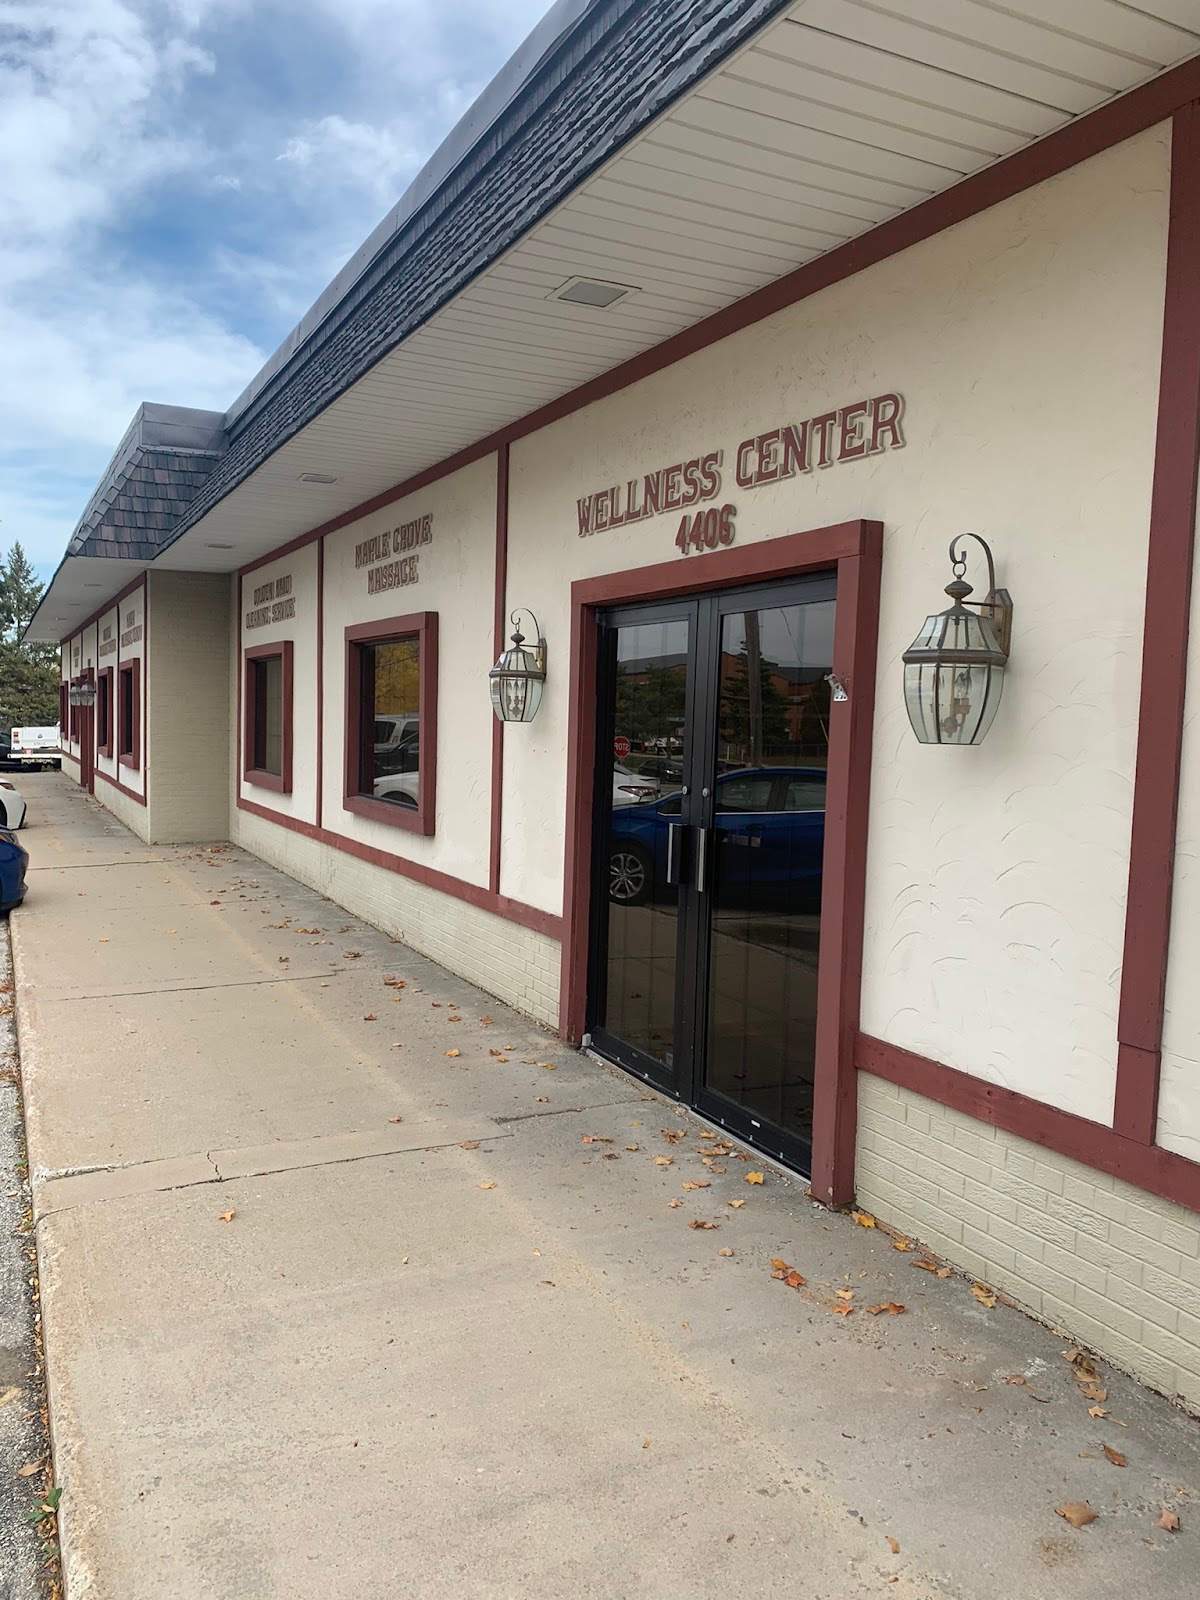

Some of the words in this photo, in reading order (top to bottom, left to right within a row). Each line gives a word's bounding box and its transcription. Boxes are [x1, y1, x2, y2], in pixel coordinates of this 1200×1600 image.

[576, 449, 724, 538] WELLNESS
[735, 392, 906, 490] CENTER
[355, 530, 391, 569] MAPLE
[675, 503, 737, 555] 4406
[367, 554, 419, 595] MASSAGE
